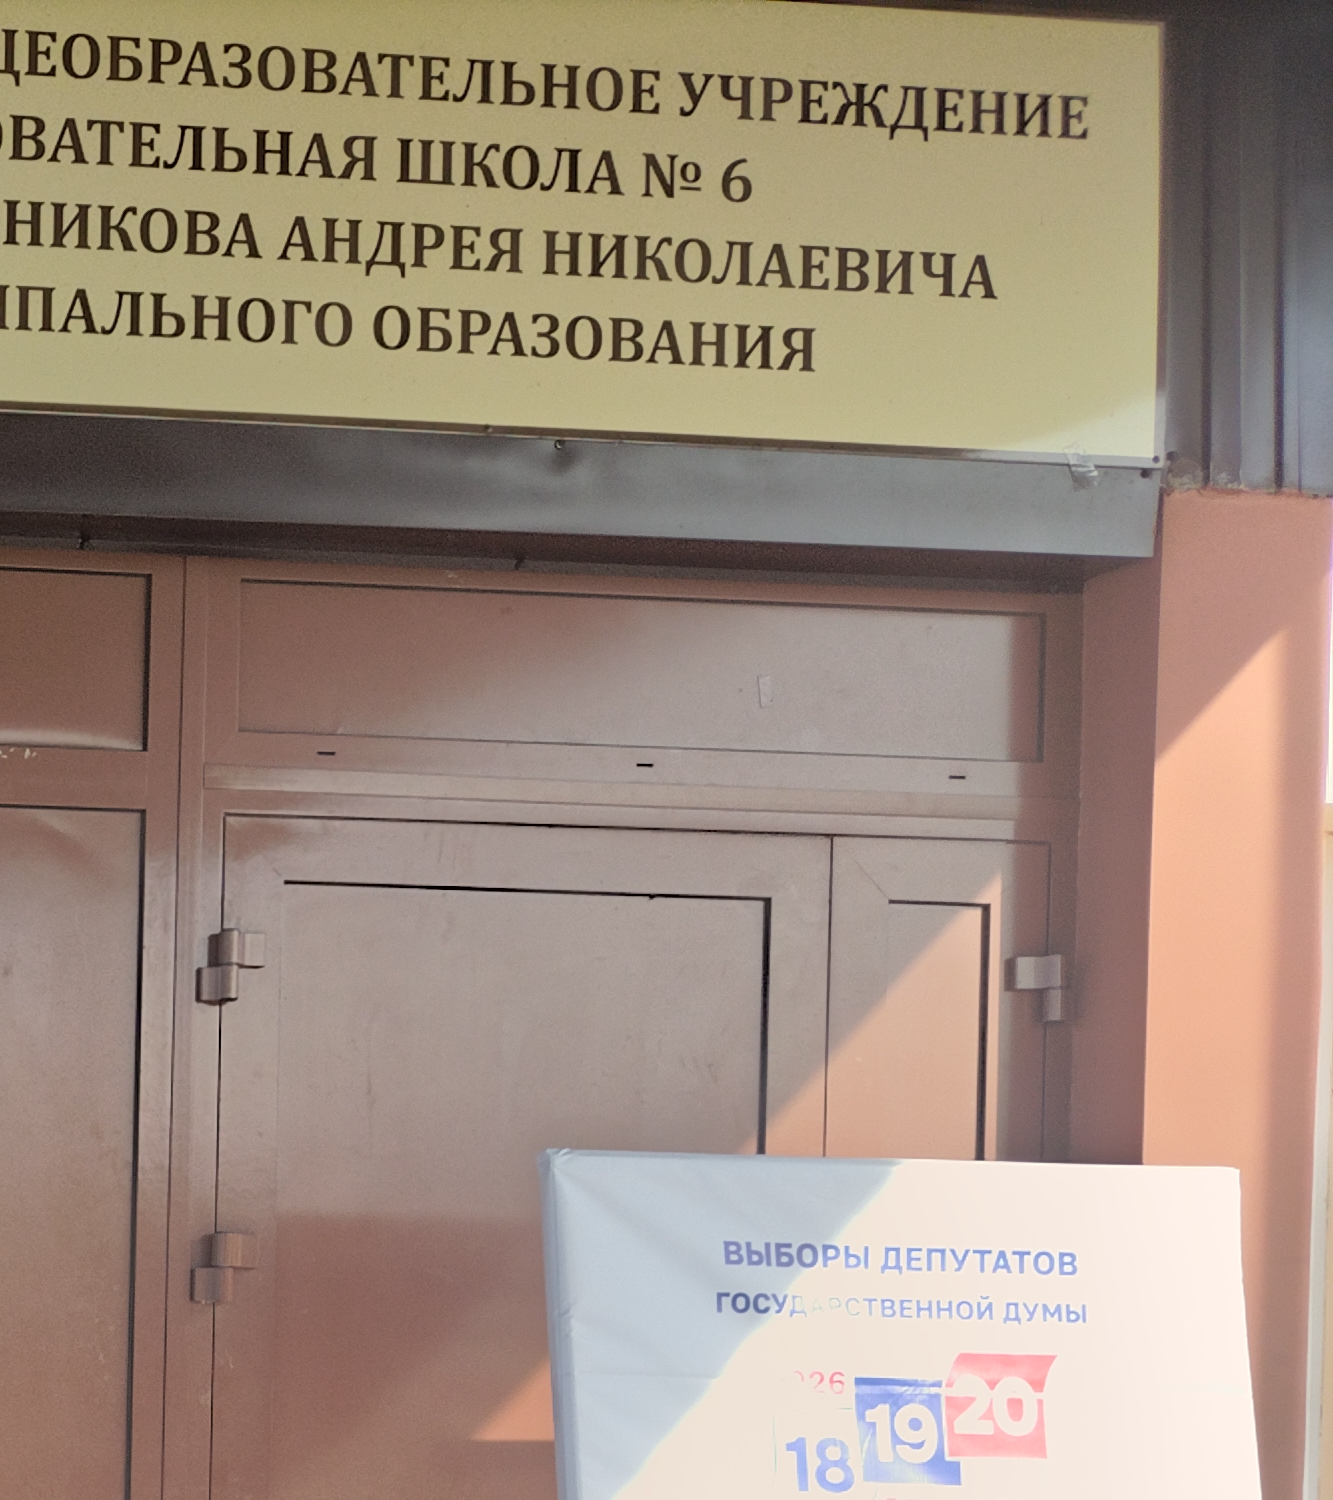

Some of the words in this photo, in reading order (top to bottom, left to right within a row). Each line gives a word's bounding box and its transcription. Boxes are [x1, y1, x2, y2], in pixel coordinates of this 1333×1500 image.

[678, 72, 1089, 140] УЧРЕЖДЕНИЕ
[396, 138, 625, 196] ШКОЛА
[641, 152, 702, 199] №
[721, 158, 753, 203] 6
[276, 216, 524, 274] АНДРЕЯ
[542, 230, 999, 300] НИКОЛАЕВИЧА
[373, 306, 816, 373] ОБРАЗОВАНИЯ
[722, 1240, 869, 1270] ВЫБОРЫ
[880, 1246, 1079, 1277] ДЕПУТАТОВ
[1002, 1301, 1088, 1326] ДУМЫ
[785, 1436, 855, 1494] 18
[864, 1403, 939, 1465] 19
[952, 1373, 1039, 1437] 20
